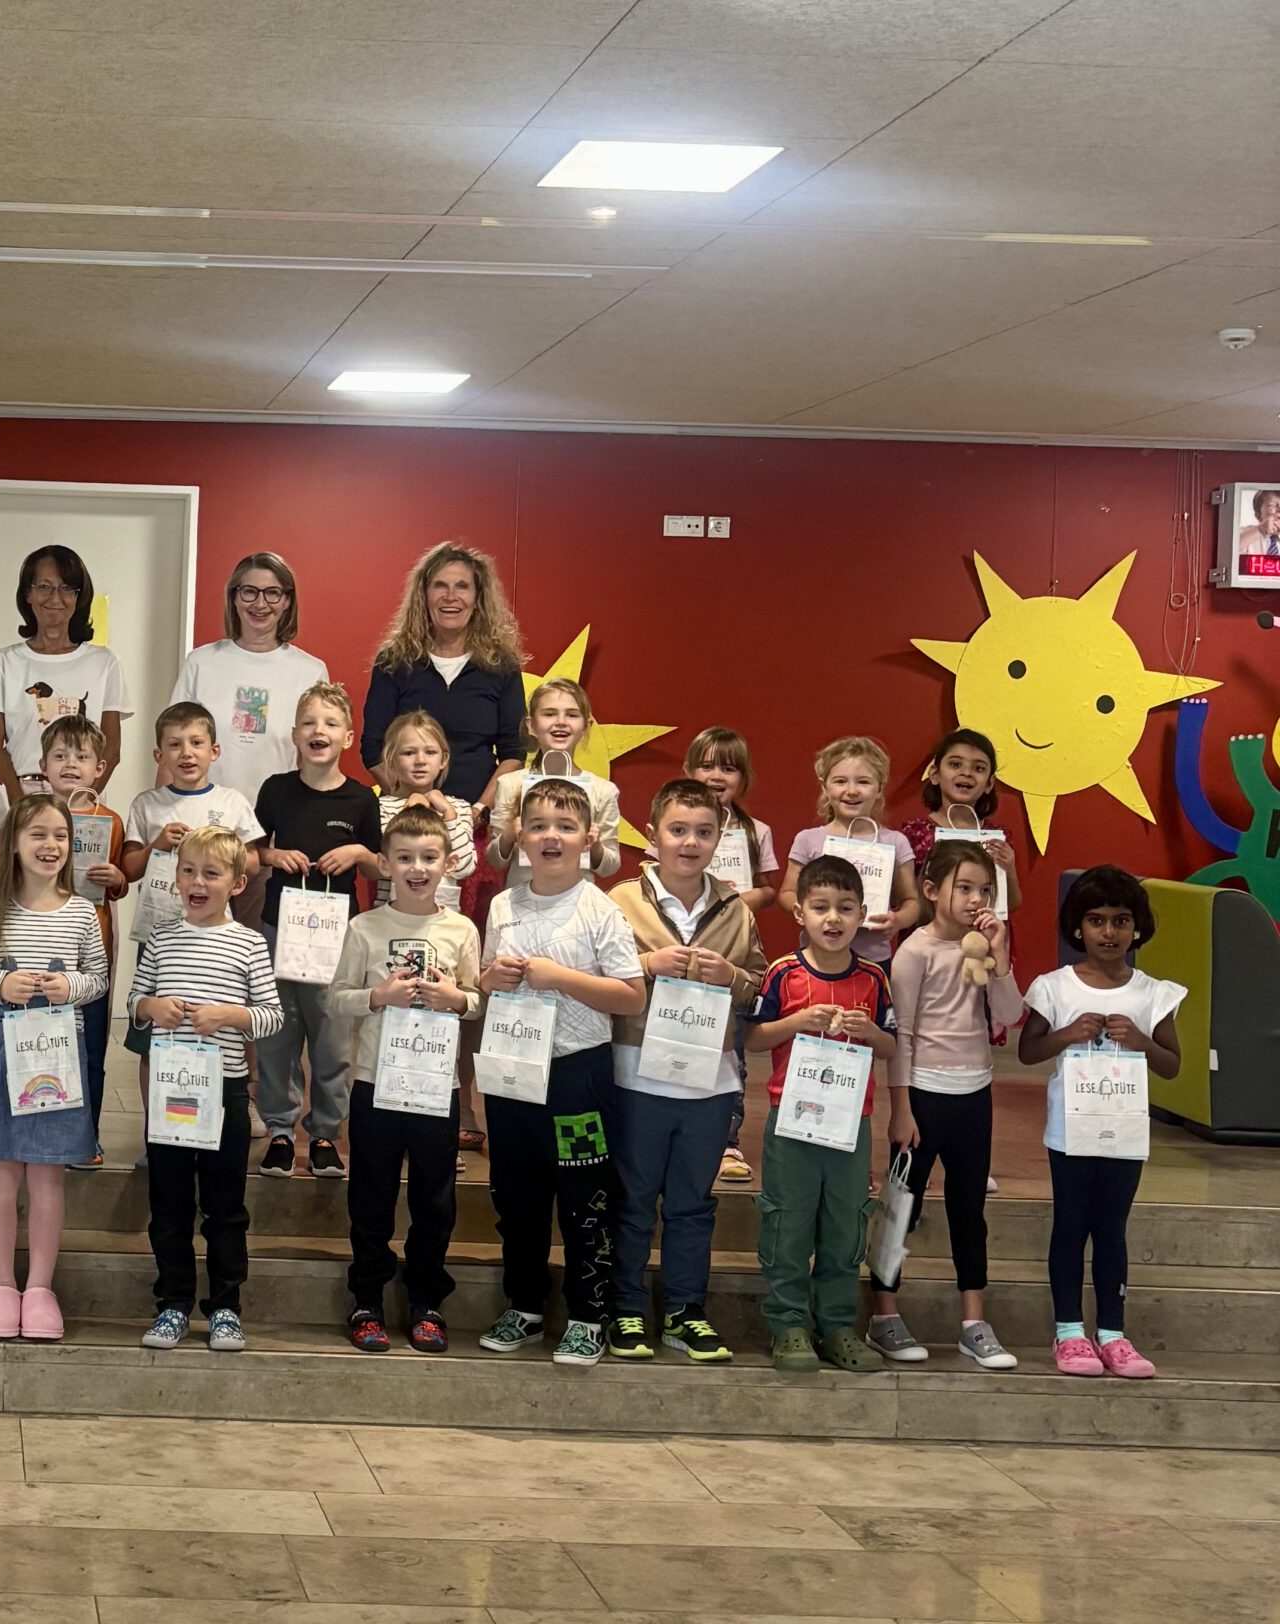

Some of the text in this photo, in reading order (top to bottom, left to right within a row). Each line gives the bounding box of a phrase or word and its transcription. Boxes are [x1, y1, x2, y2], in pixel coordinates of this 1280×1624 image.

[83, 842, 101, 853] TÜTE
[722, 856, 741, 868] TÜTE
[150, 878, 168, 890] LESE
[288, 915, 304, 926] LESE
[658, 1008, 716, 1028] LESE TÜTE
[492, 1022, 541, 1040] LESE TÜTE
[16, 1036, 70, 1052] LESE TÜTE
[391, 1037, 446, 1054] LESE TÜTE
[156, 1072, 210, 1086] LESE TÜTE
[798, 1066, 856, 1088] LESE TÜTE
[1076, 1082, 1136, 1094] LESE TÜTE
[558, 1154, 609, 1166] MINECRAFT
